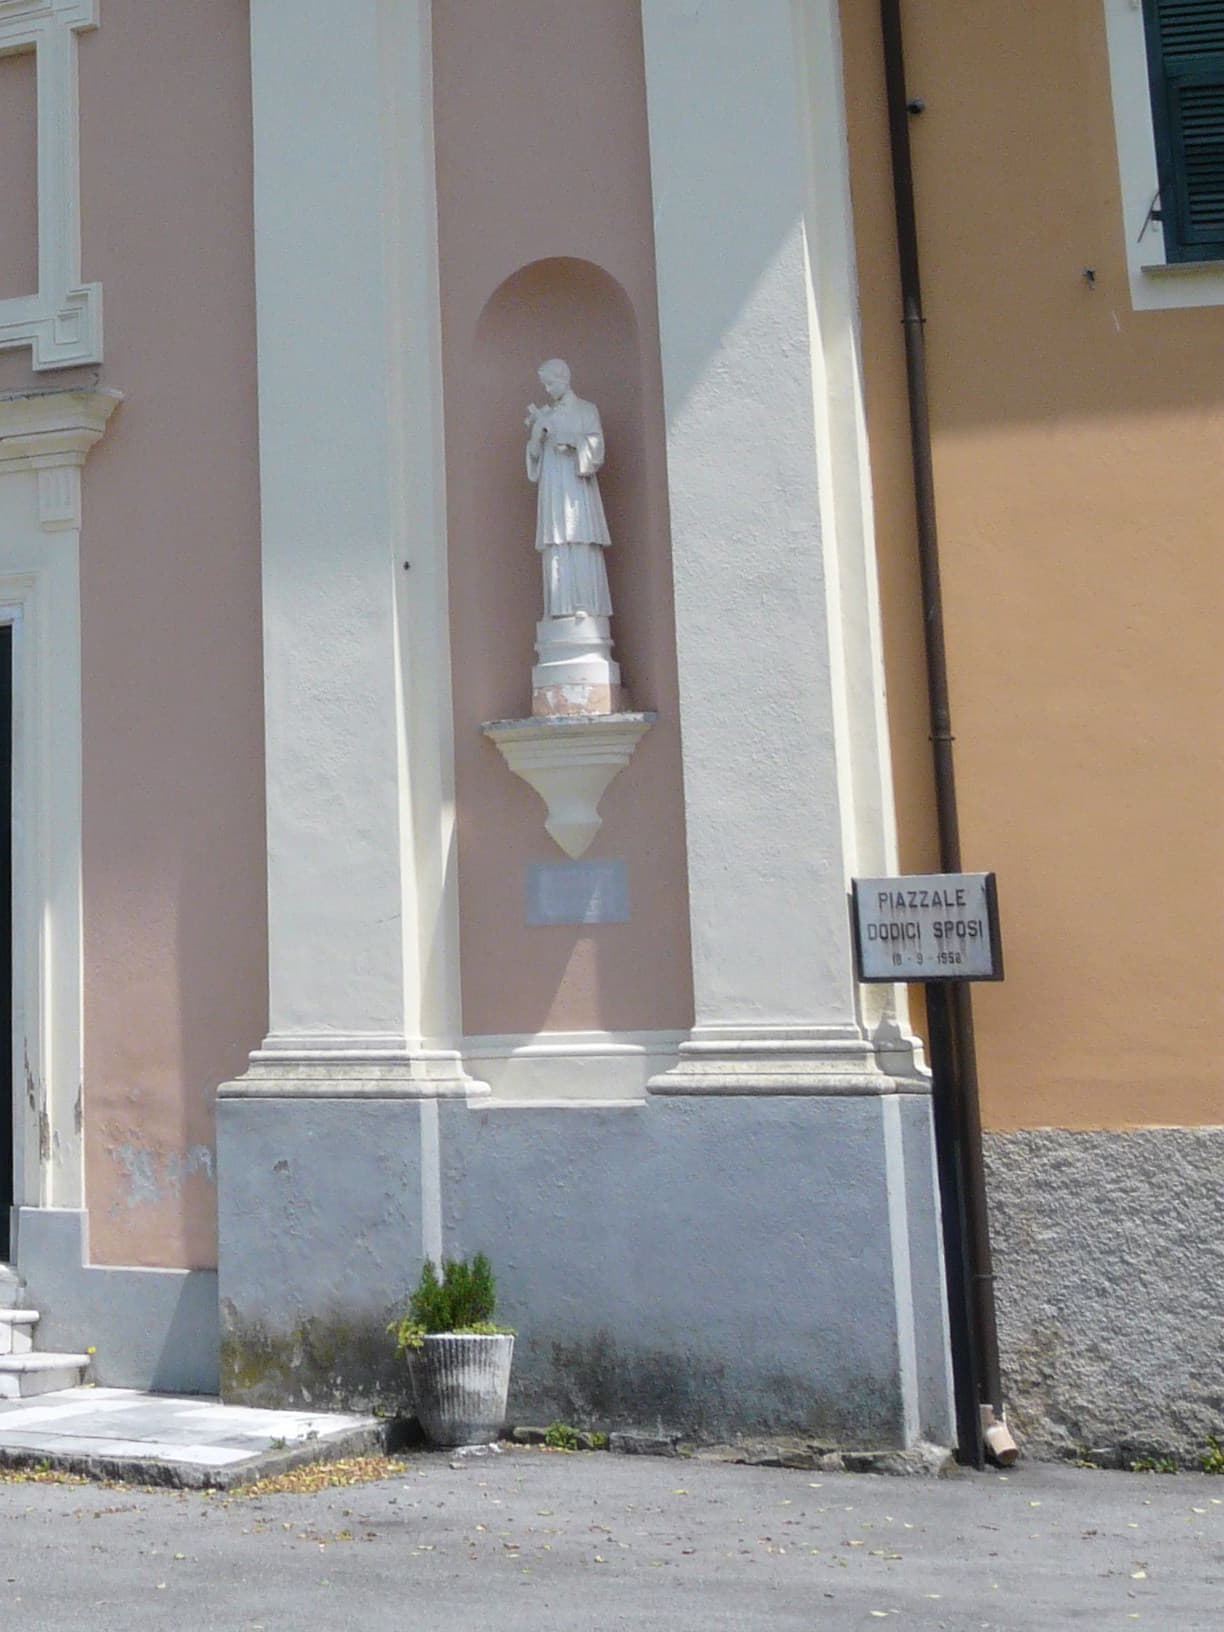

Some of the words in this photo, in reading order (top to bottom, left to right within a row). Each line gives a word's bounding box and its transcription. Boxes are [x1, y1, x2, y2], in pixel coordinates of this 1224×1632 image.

[878, 889, 967, 910] PIAZZALE
[867, 922, 921, 941] DODICI
[932, 920, 984, 939] SPOSI
